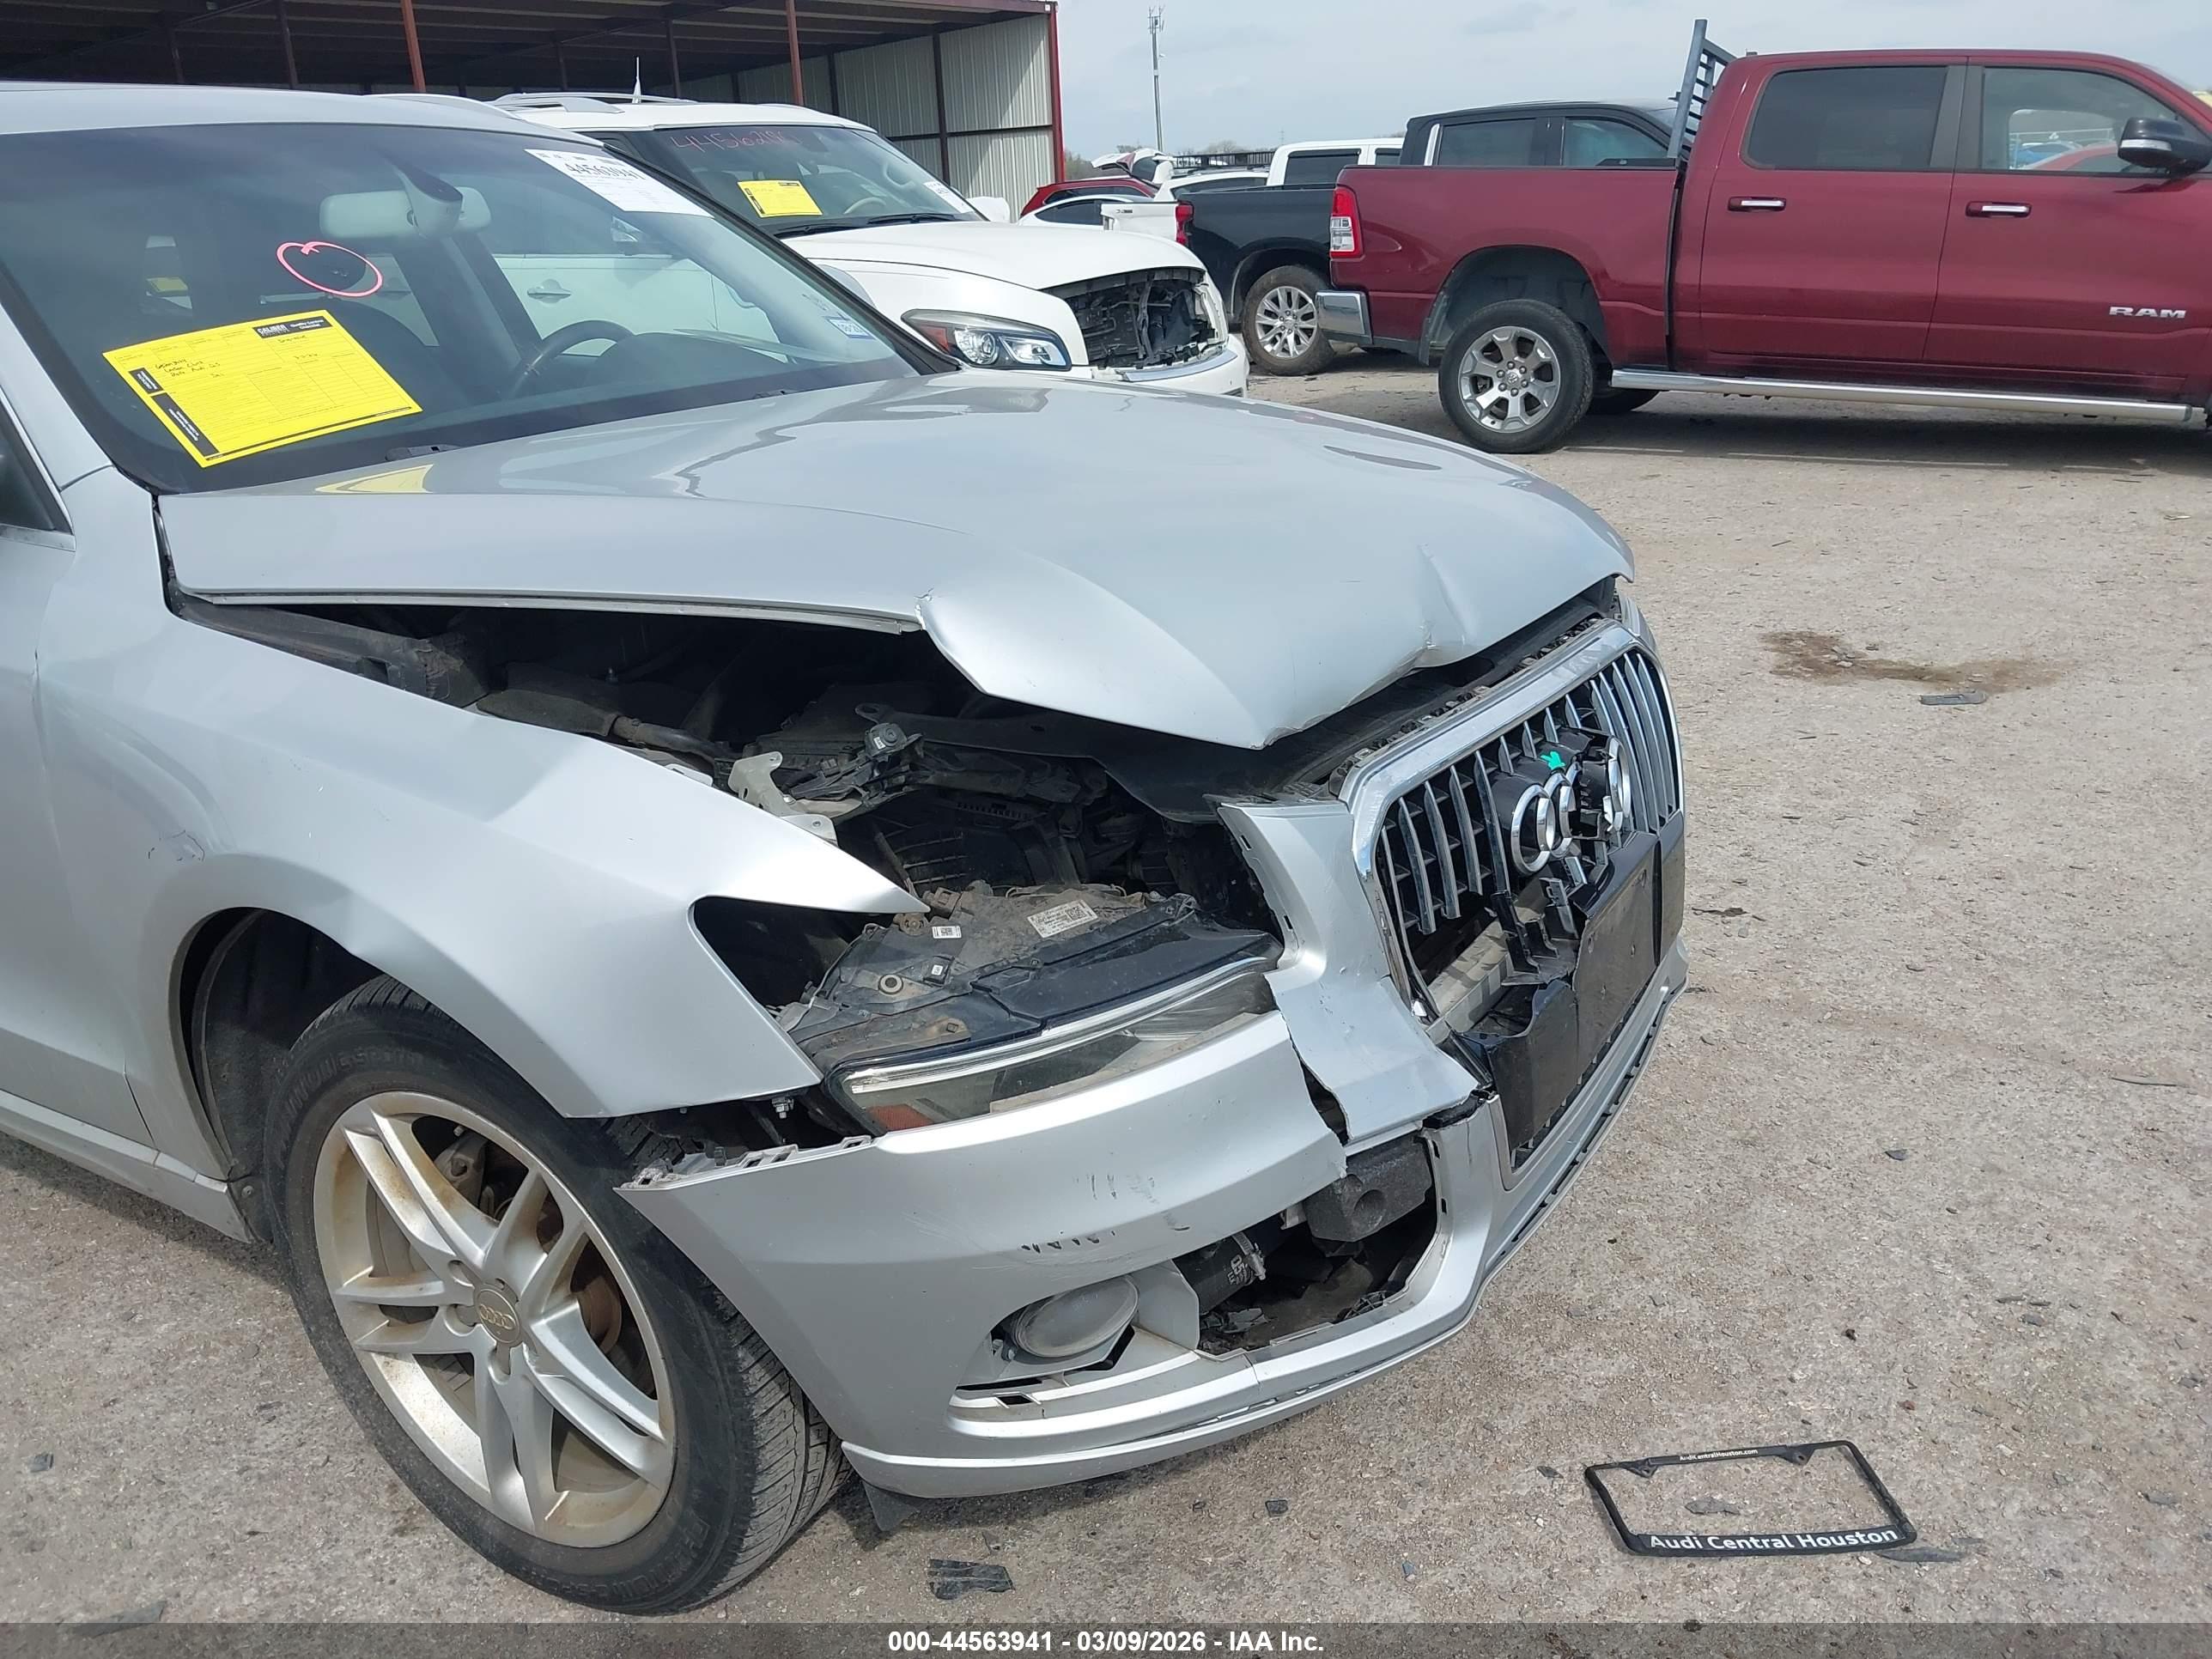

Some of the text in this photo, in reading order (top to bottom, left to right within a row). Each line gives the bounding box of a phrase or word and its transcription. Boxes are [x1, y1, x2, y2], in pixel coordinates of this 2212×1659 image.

[2109, 307, 2186, 319] RAM
[1650, 1529, 1899, 1549] Audi Central Houston
